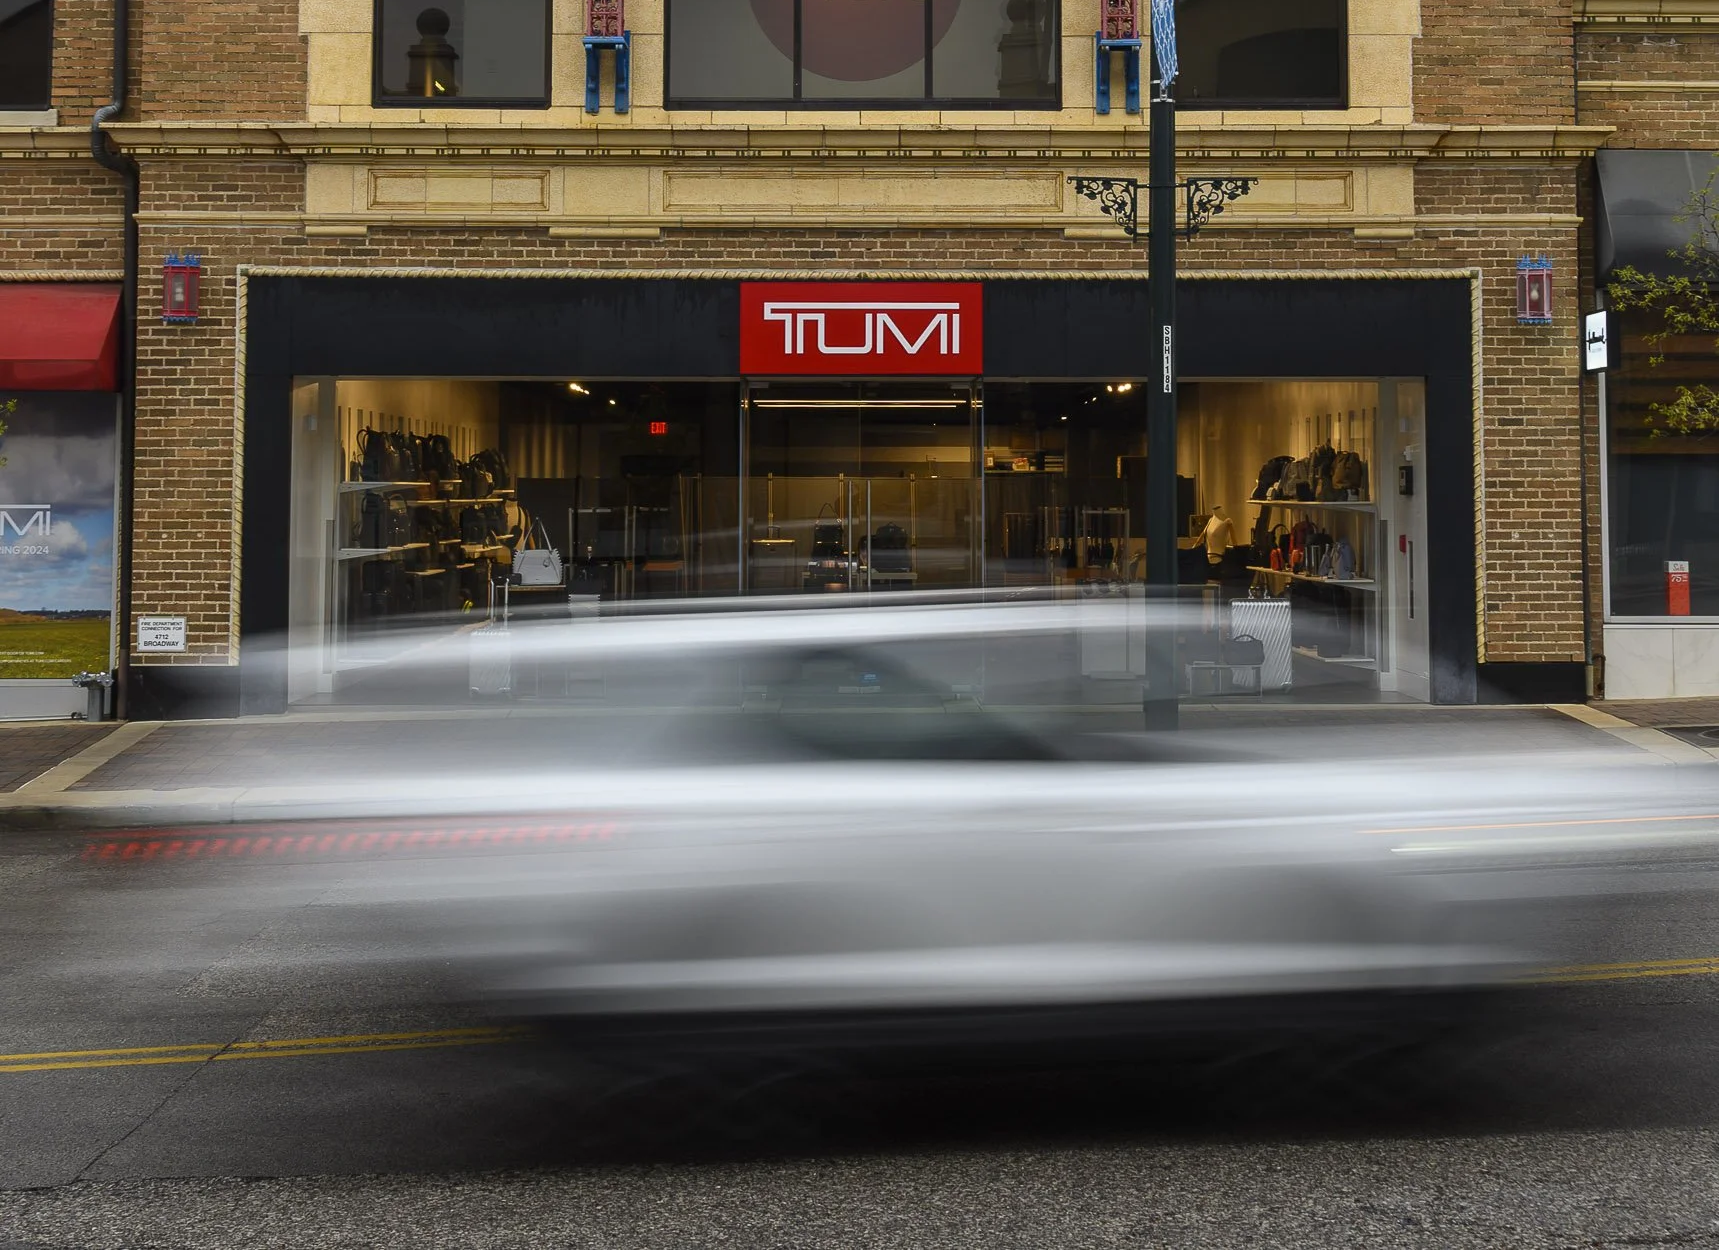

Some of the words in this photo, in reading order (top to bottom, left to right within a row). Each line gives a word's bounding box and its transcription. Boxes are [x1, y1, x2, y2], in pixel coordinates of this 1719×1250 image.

[764, 302, 959, 354] TUMI
[651, 422, 666, 434] EXIT
[0, 505, 50, 535] MI
[0, 546, 20, 554] ING
[22, 546, 49, 554] 2024
